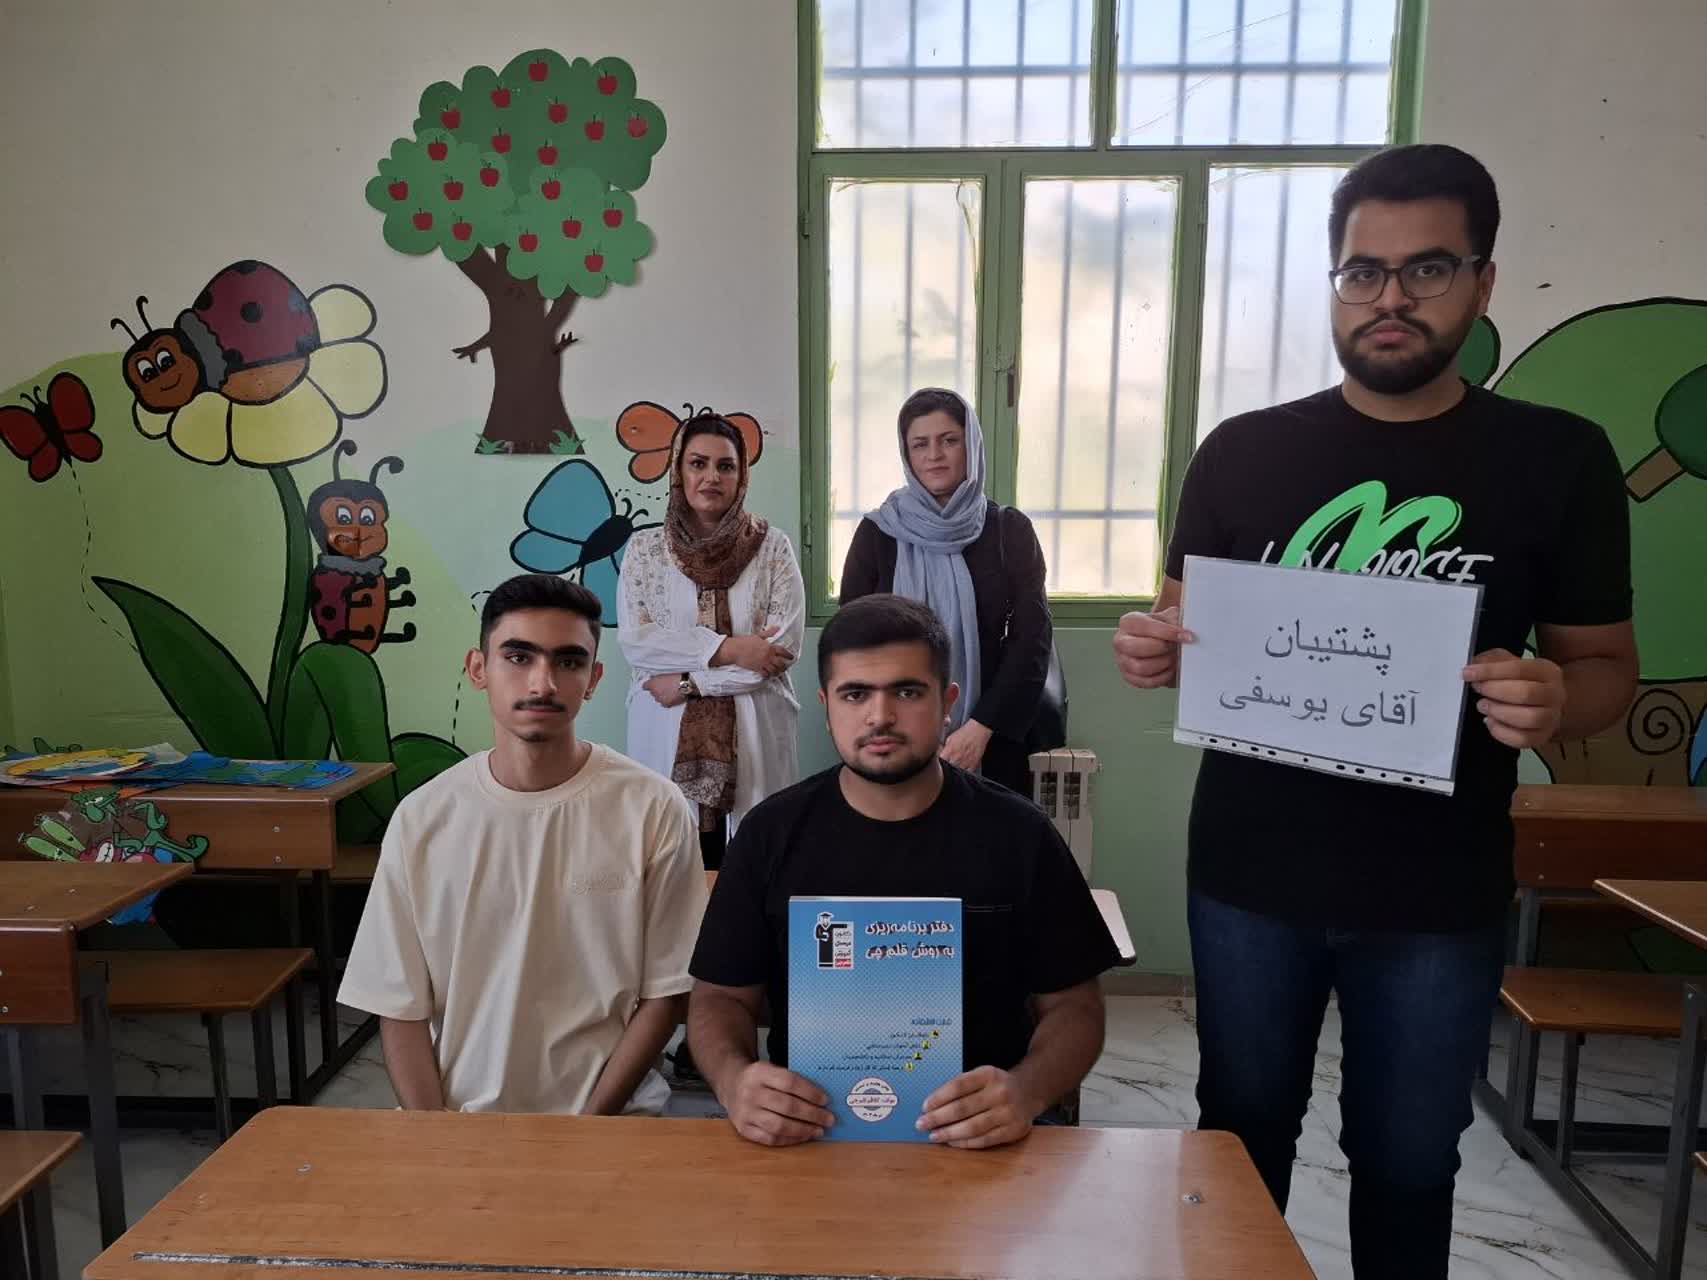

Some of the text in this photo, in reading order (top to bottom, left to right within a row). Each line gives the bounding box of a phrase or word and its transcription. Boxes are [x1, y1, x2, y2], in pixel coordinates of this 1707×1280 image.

[1265, 619, 1392, 676] پشتیبان
[1219, 676, 1420, 727] آقای یوسفی
[930, 920, 955, 936] دفتر
[886, 943, 908, 959] قلم
[911, 942, 940, 959] روش
[942, 945, 955, 959] به
